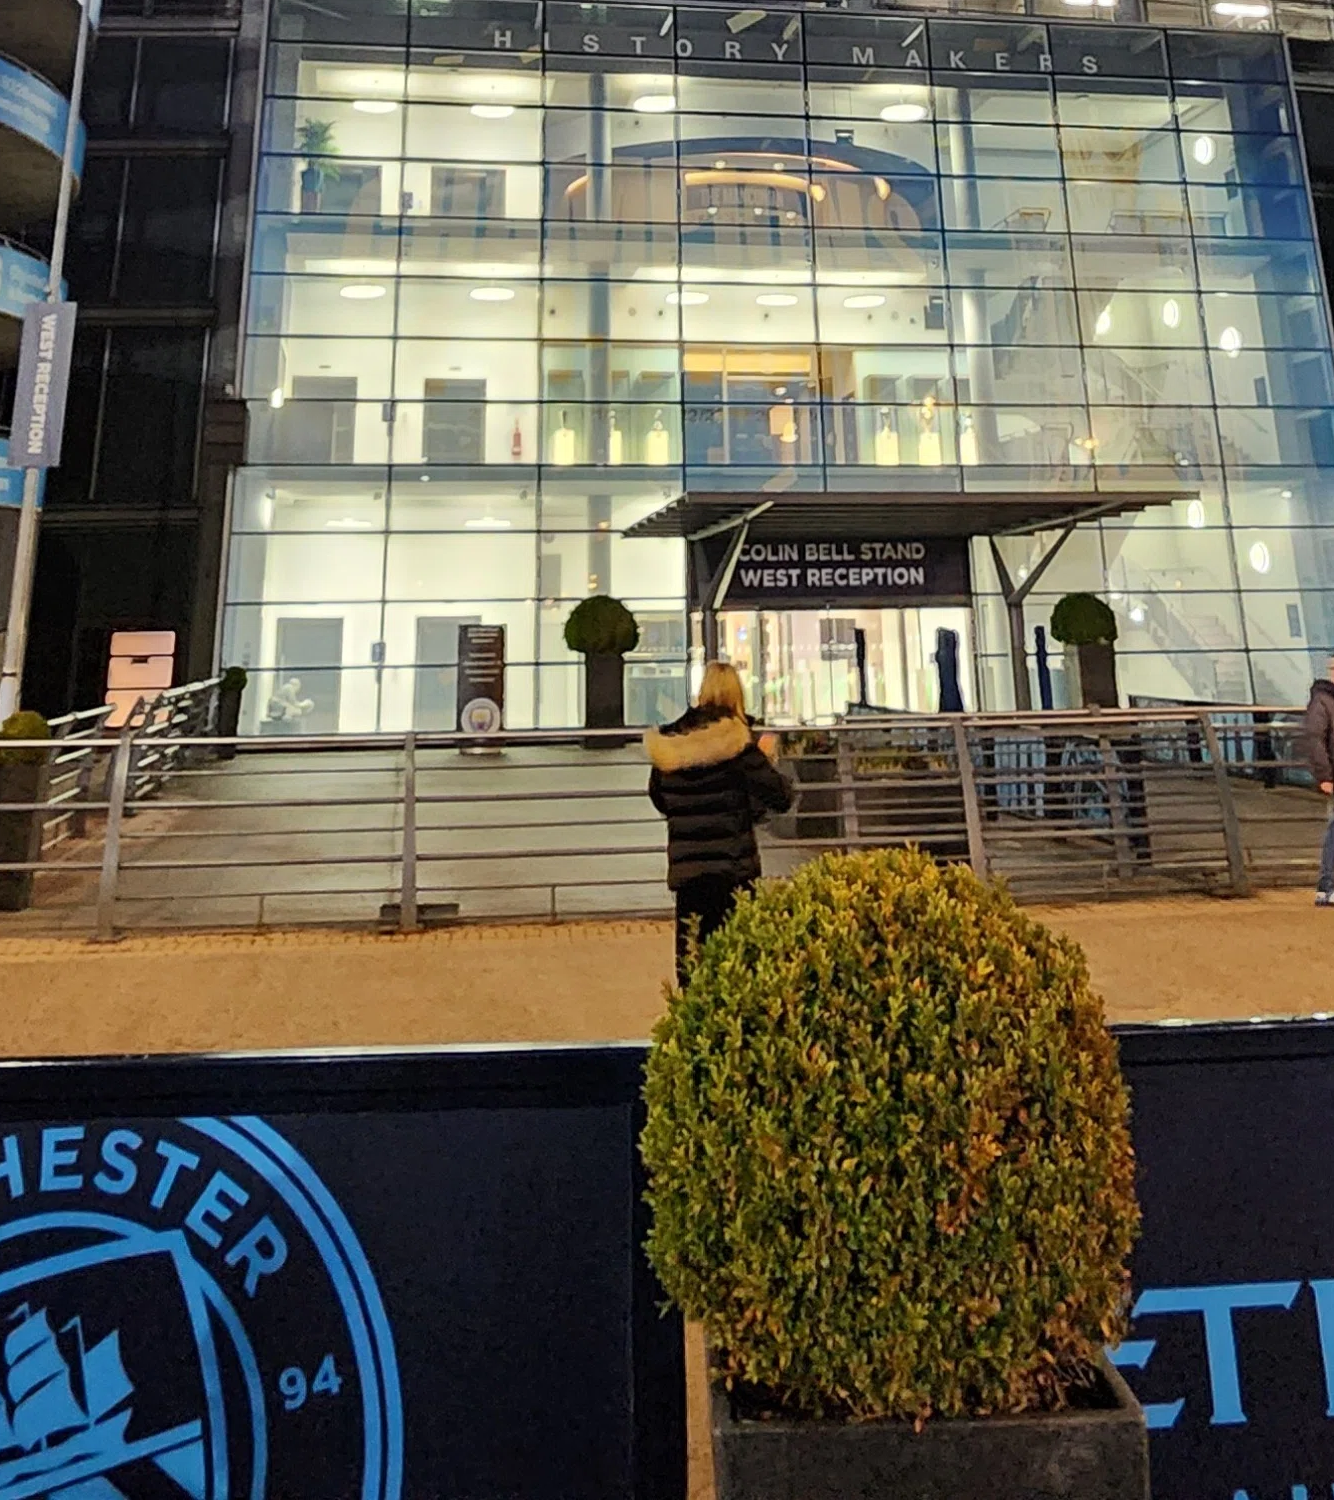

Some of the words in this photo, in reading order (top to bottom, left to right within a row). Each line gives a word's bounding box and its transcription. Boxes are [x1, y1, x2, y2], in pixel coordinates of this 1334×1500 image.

[493, 31, 789, 62] HISTORY
[852, 46, 1099, 74] MAKERS
[39, 313, 57, 359] WEST
[28, 361, 53, 454] RECEPTION
[738, 544, 799, 563] COLIN
[805, 543, 855, 562] BELL
[860, 541, 925, 560] STAND
[739, 568, 800, 587] WEST
[806, 566, 924, 587] RECEPTION
[279, 1355, 343, 1411] 94
